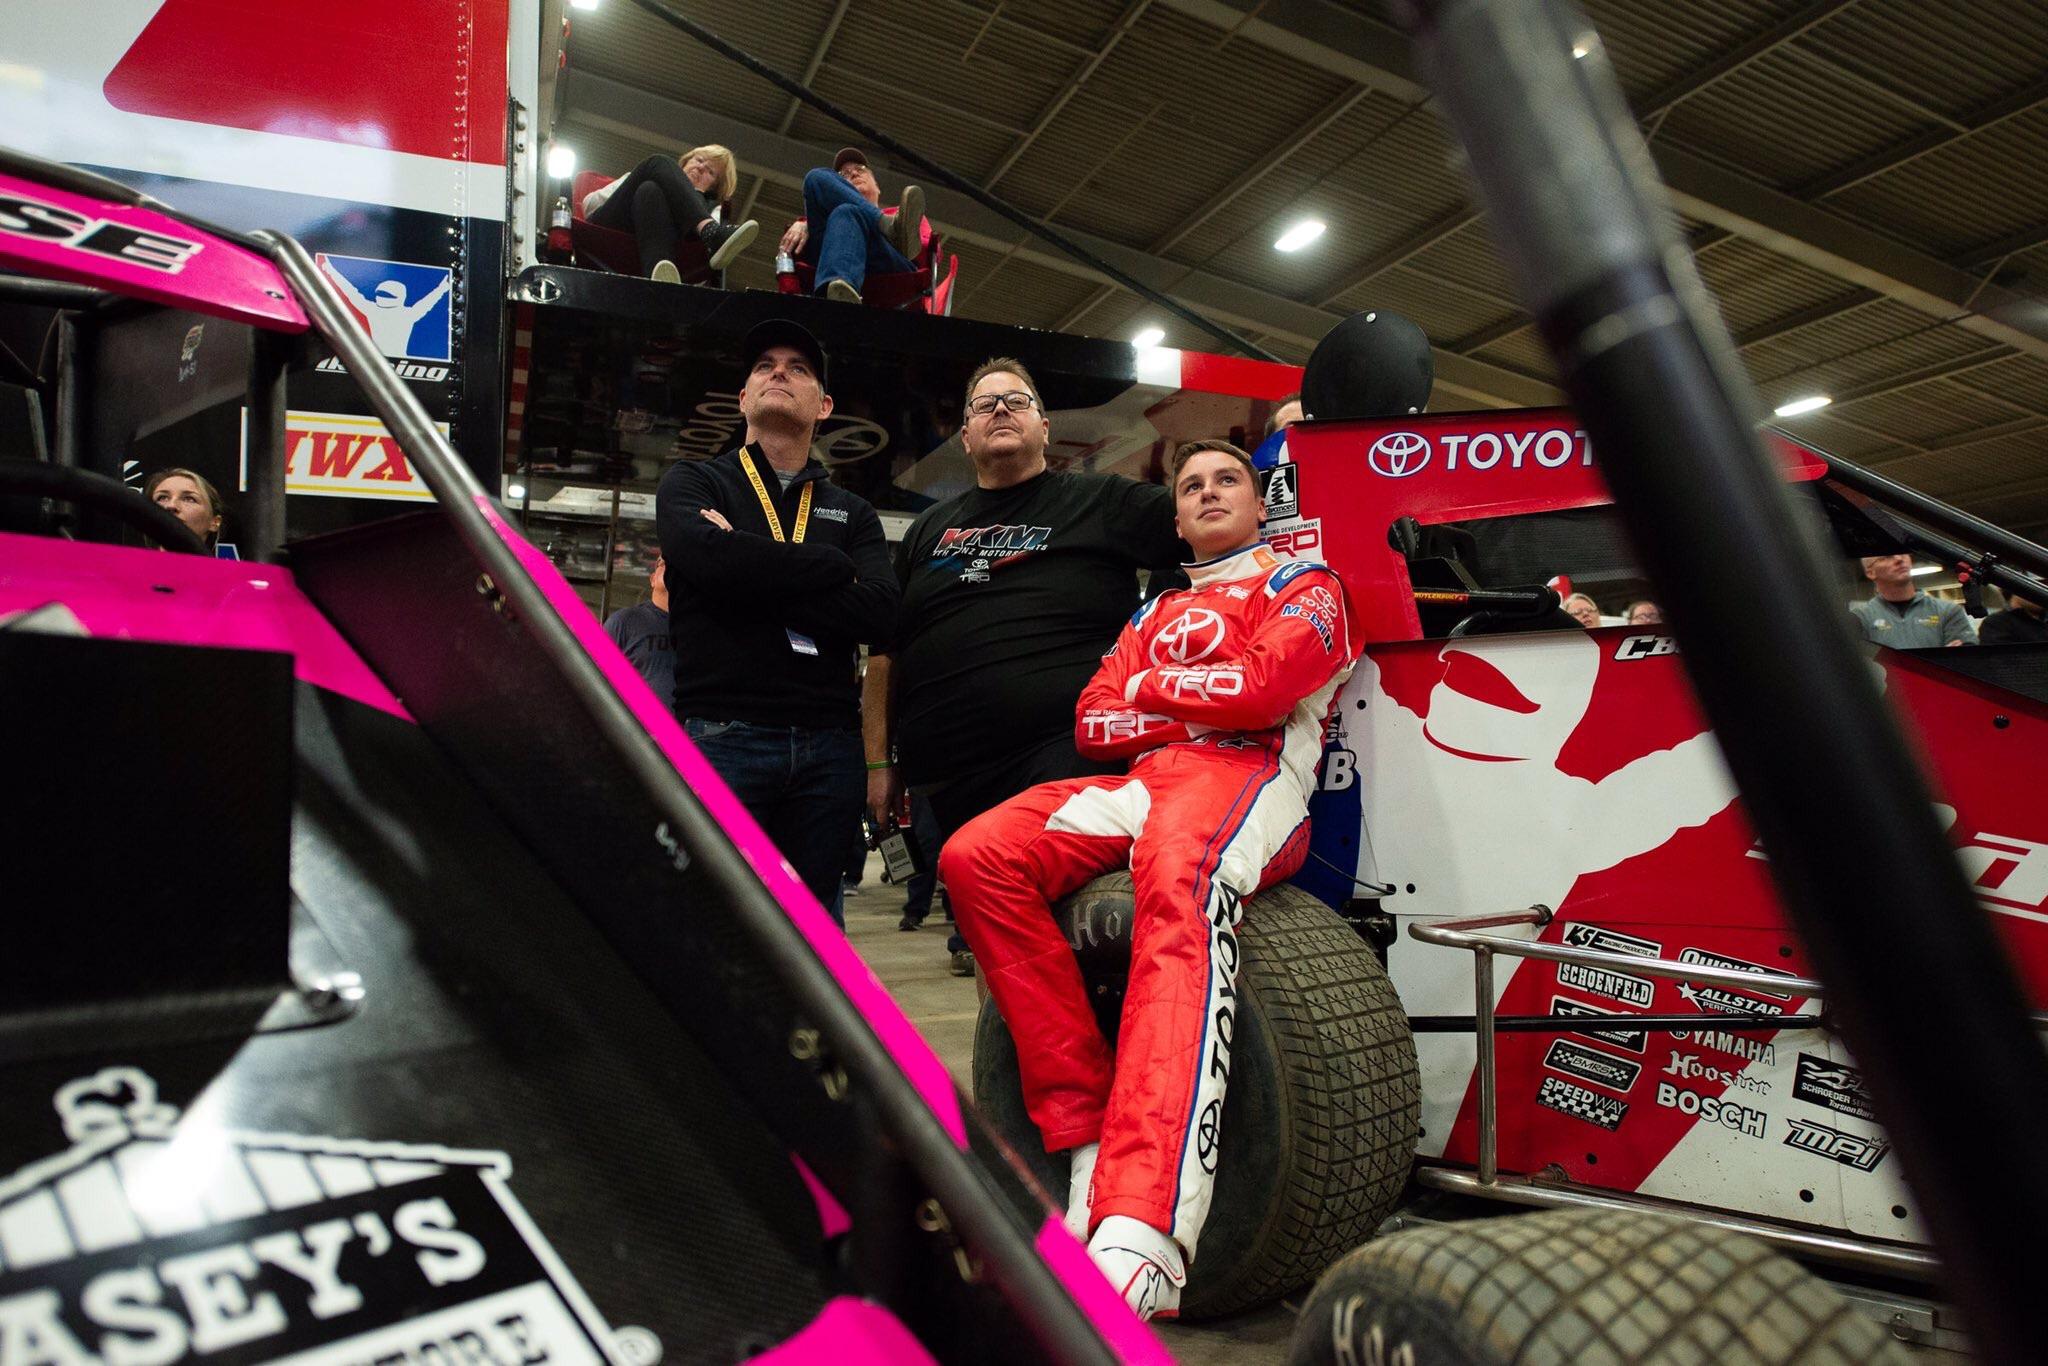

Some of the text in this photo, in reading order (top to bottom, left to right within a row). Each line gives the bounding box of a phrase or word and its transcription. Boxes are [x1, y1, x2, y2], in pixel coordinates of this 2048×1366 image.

[1441, 430, 1592, 470] TOYOT
[767, 511, 784, 541] HARVES
[1281, 521, 1318, 534] DEVELOPMENT
[1260, 528, 1319, 557] RD
[1158, 670, 1244, 702] TRD
[1561, 963, 1650, 1004] SCHOENFELD
[1699, 987, 1783, 1017] ALLSTAR
[1693, 1030, 1776, 1067] YAMAHA
[1571, 1056, 1611, 1074] BMRS
[1542, 1077, 1628, 1115] SPEEDWAY
[1800, 1082, 1851, 1104] SCHROEDER
[1827, 1099, 1857, 1115] Torsion
[1656, 1082, 1768, 1140] BOSCH
